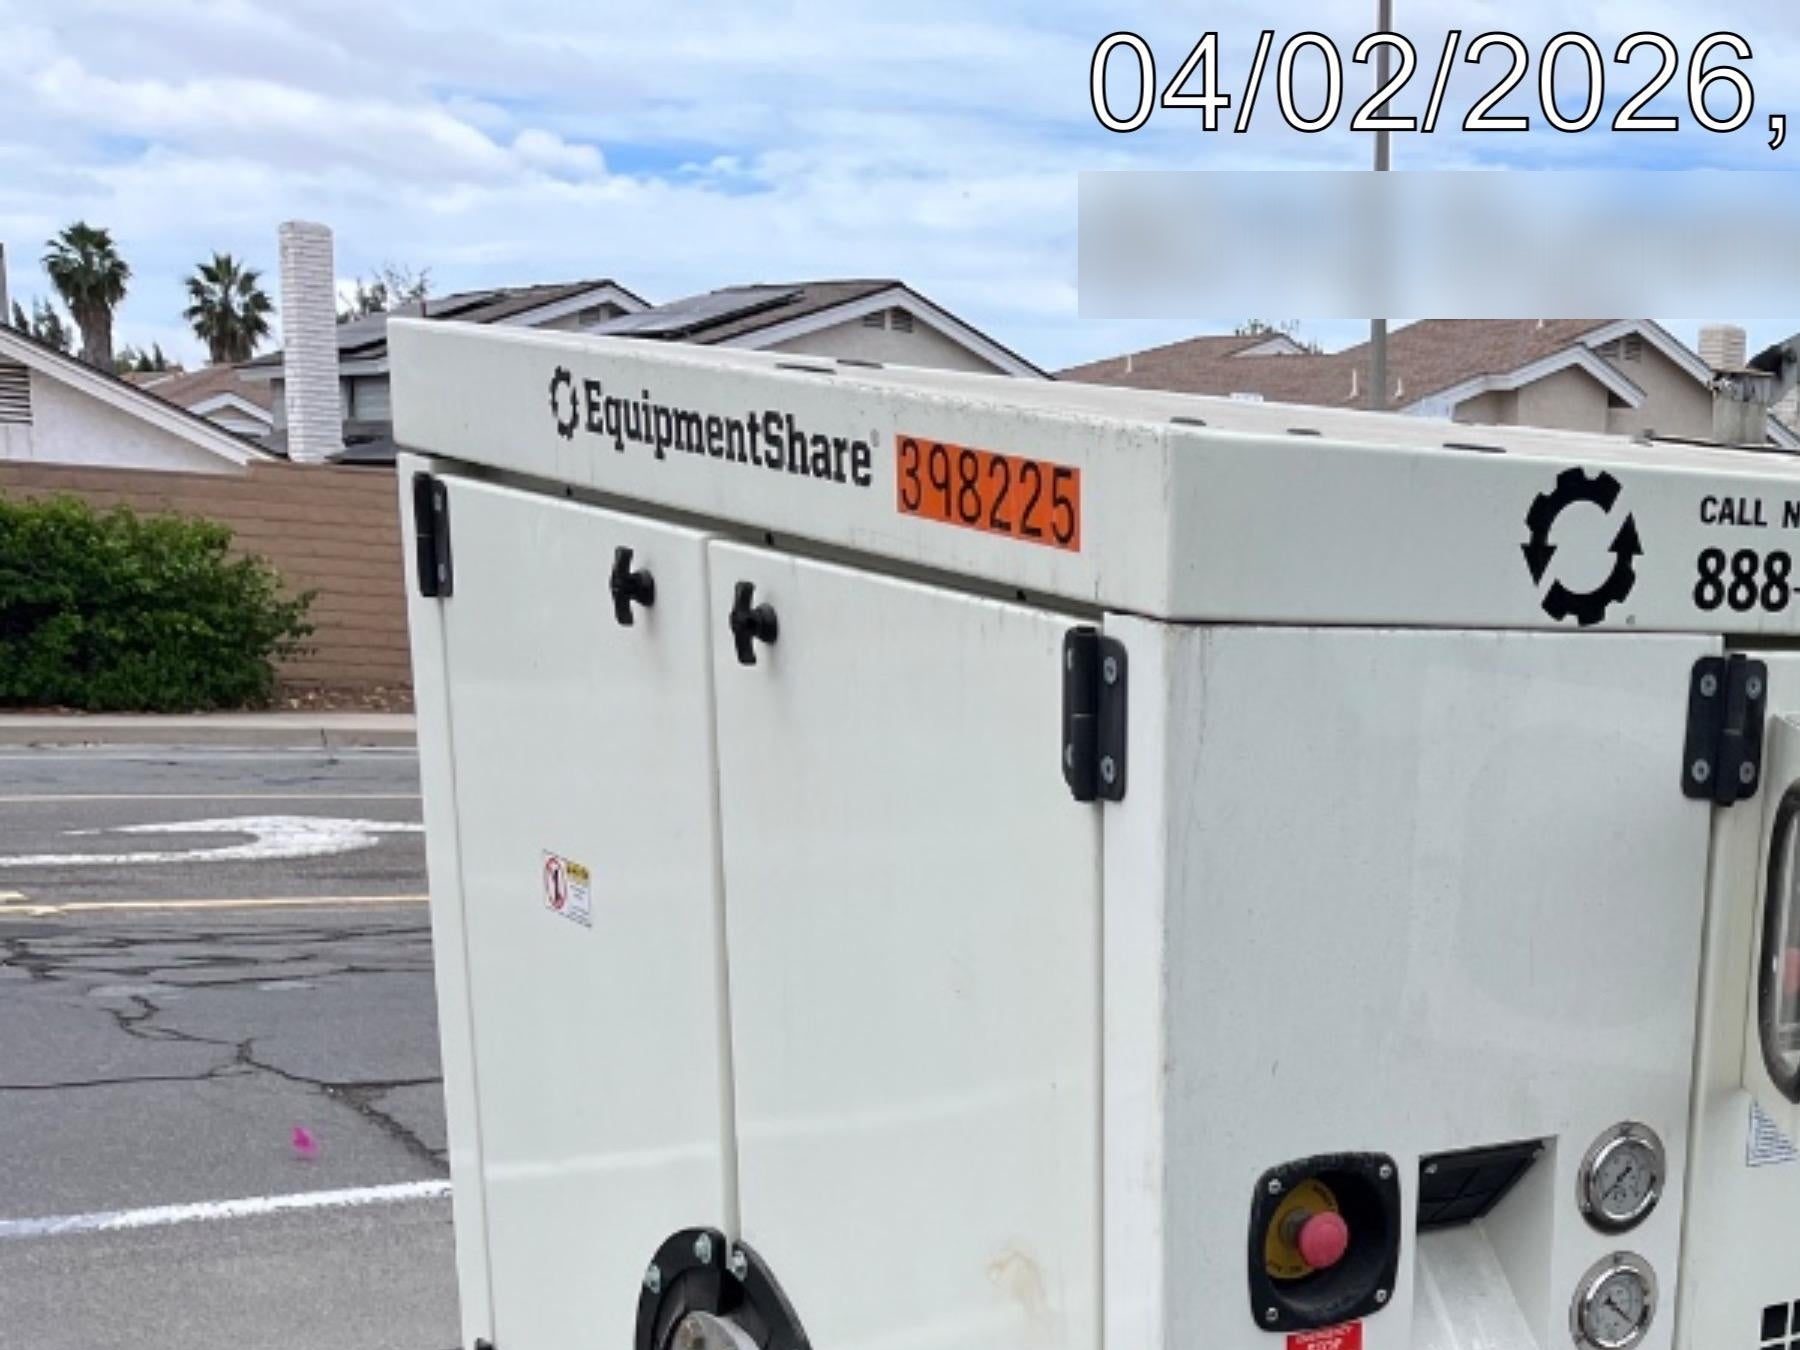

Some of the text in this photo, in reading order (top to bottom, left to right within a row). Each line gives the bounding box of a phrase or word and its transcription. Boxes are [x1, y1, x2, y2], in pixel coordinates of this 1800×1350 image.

[583, 378, 873, 487] EquipmentShare
[901, 437, 1076, 546] 398225
[1699, 495, 1768, 527] CALL
